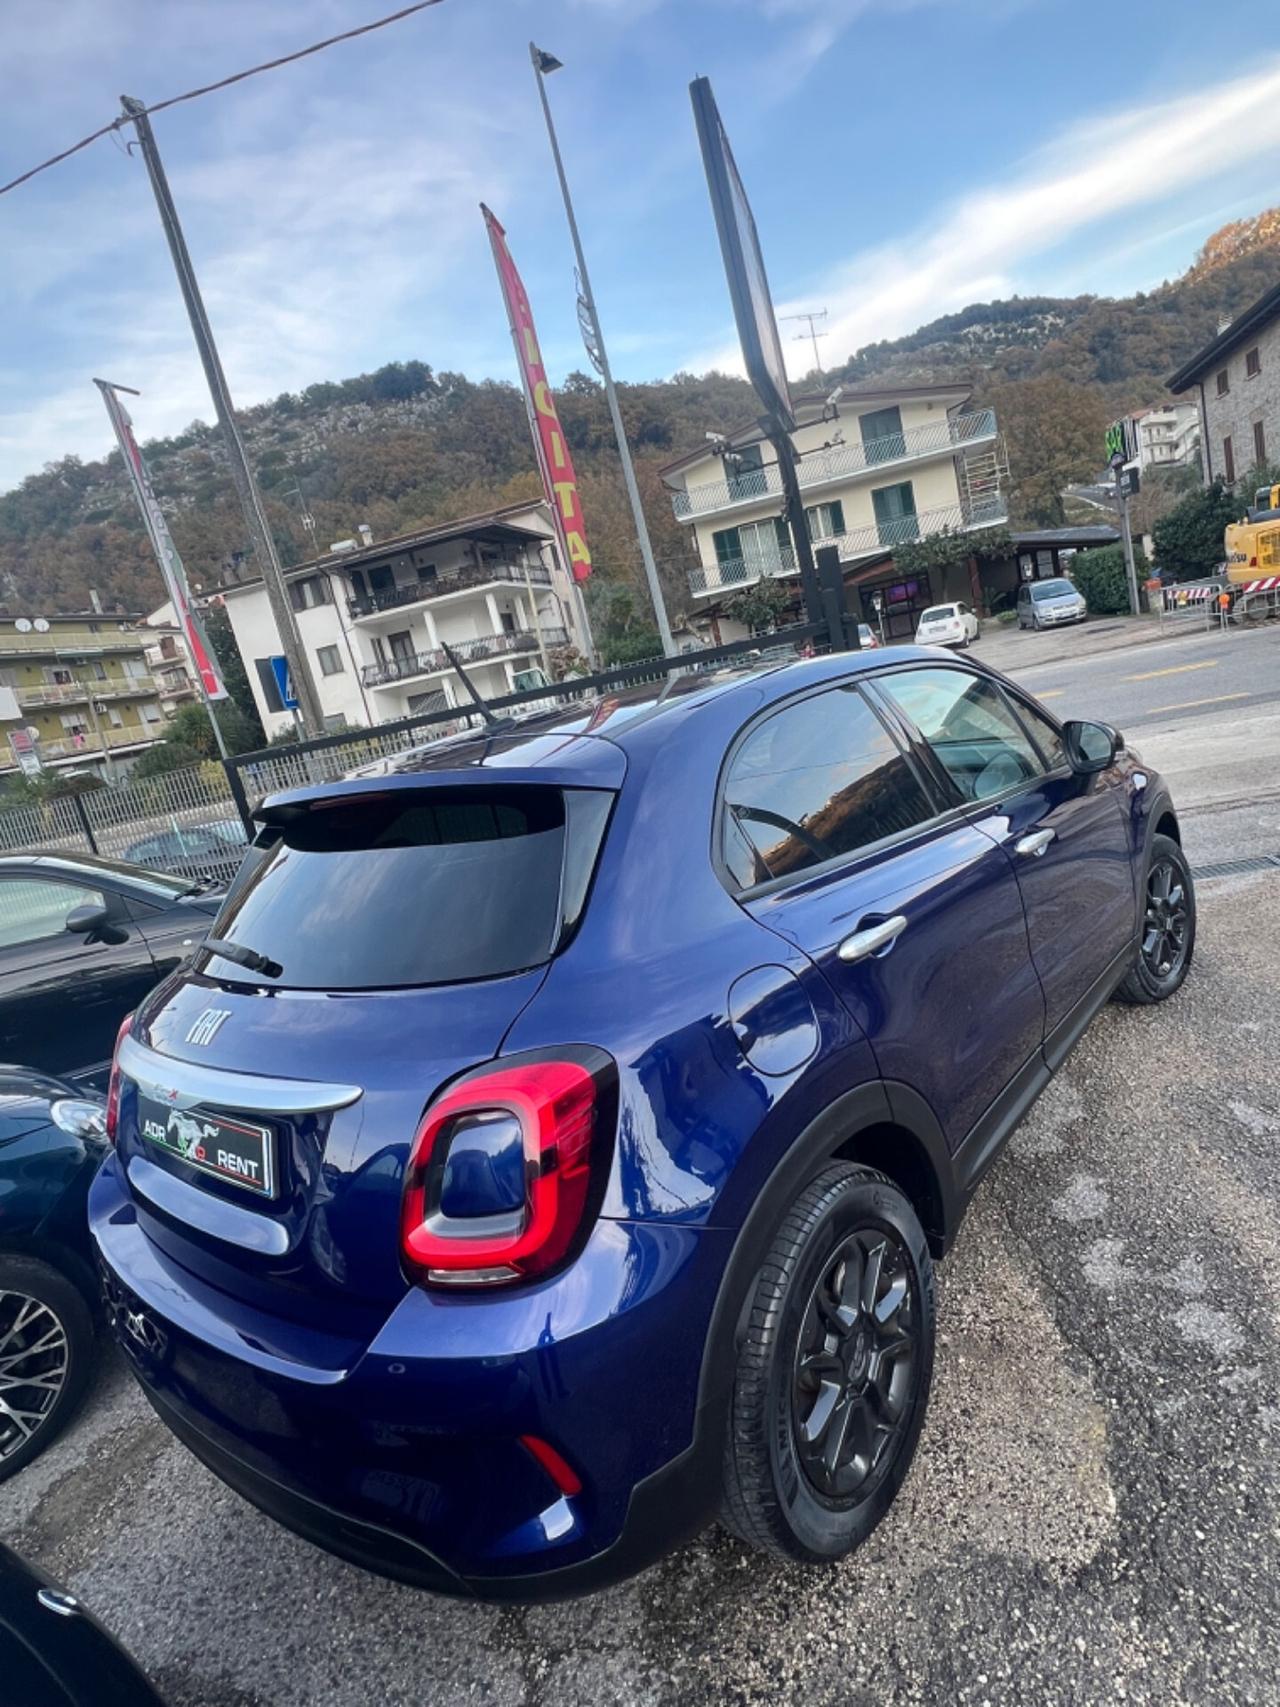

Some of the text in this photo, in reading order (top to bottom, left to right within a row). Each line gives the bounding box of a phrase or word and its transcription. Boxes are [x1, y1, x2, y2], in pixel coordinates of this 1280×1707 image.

[185, 1009, 232, 1045] FIAT
[143, 1120, 258, 1178] ADR RENT
